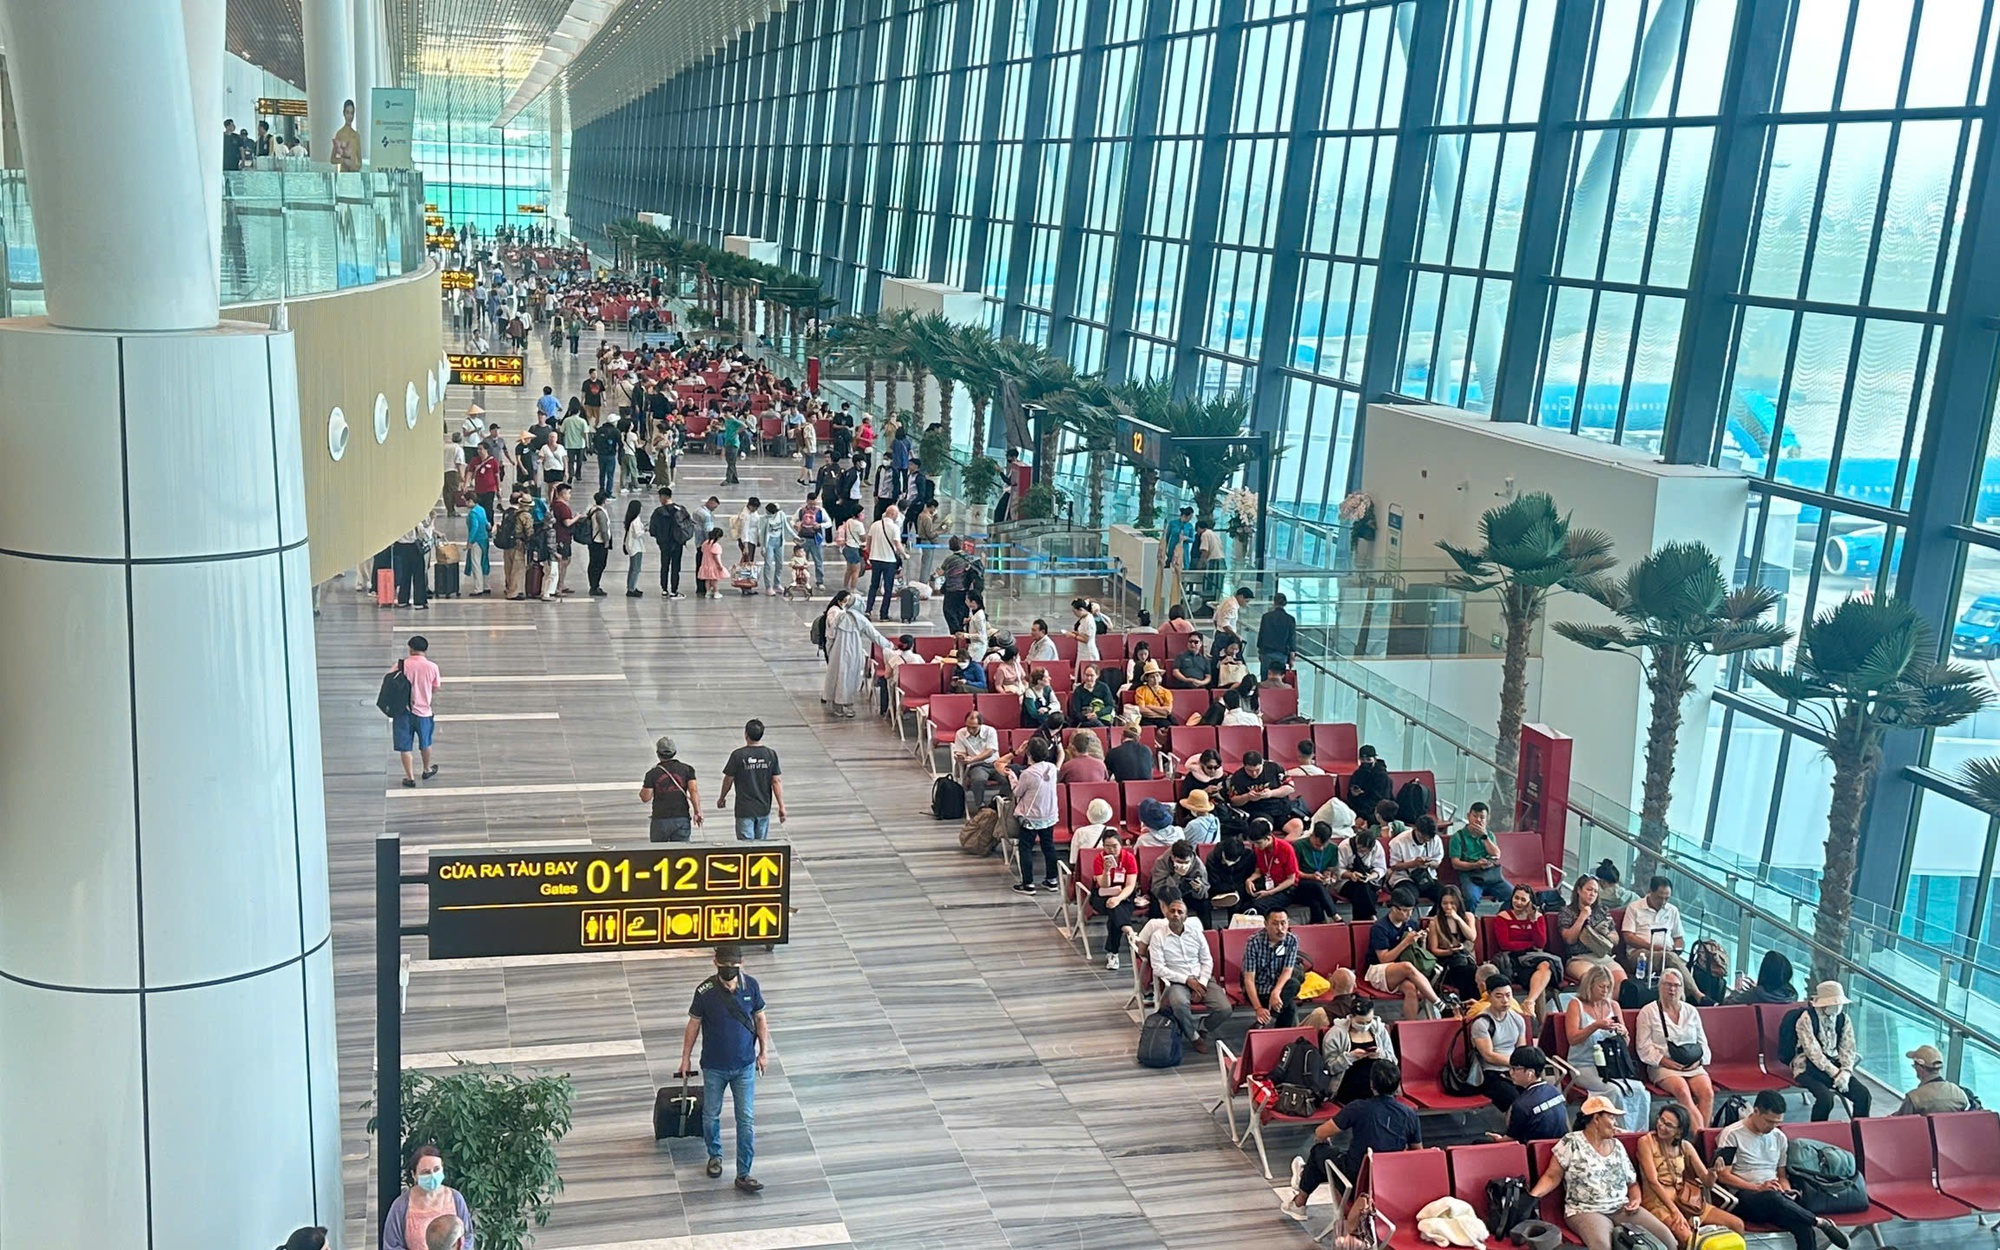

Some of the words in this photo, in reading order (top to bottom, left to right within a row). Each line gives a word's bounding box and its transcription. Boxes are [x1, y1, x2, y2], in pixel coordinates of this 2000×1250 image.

[462, 356, 496, 369] 01-11
[1133, 431, 1143, 454] 12
[439, 861, 477, 879] CỬA
[480, 864, 505, 878] RA
[507, 860, 541, 877] TÀU
[544, 861, 579, 876] BAY
[586, 857, 699, 894] 01-12
[540, 883, 578, 895] Gates
